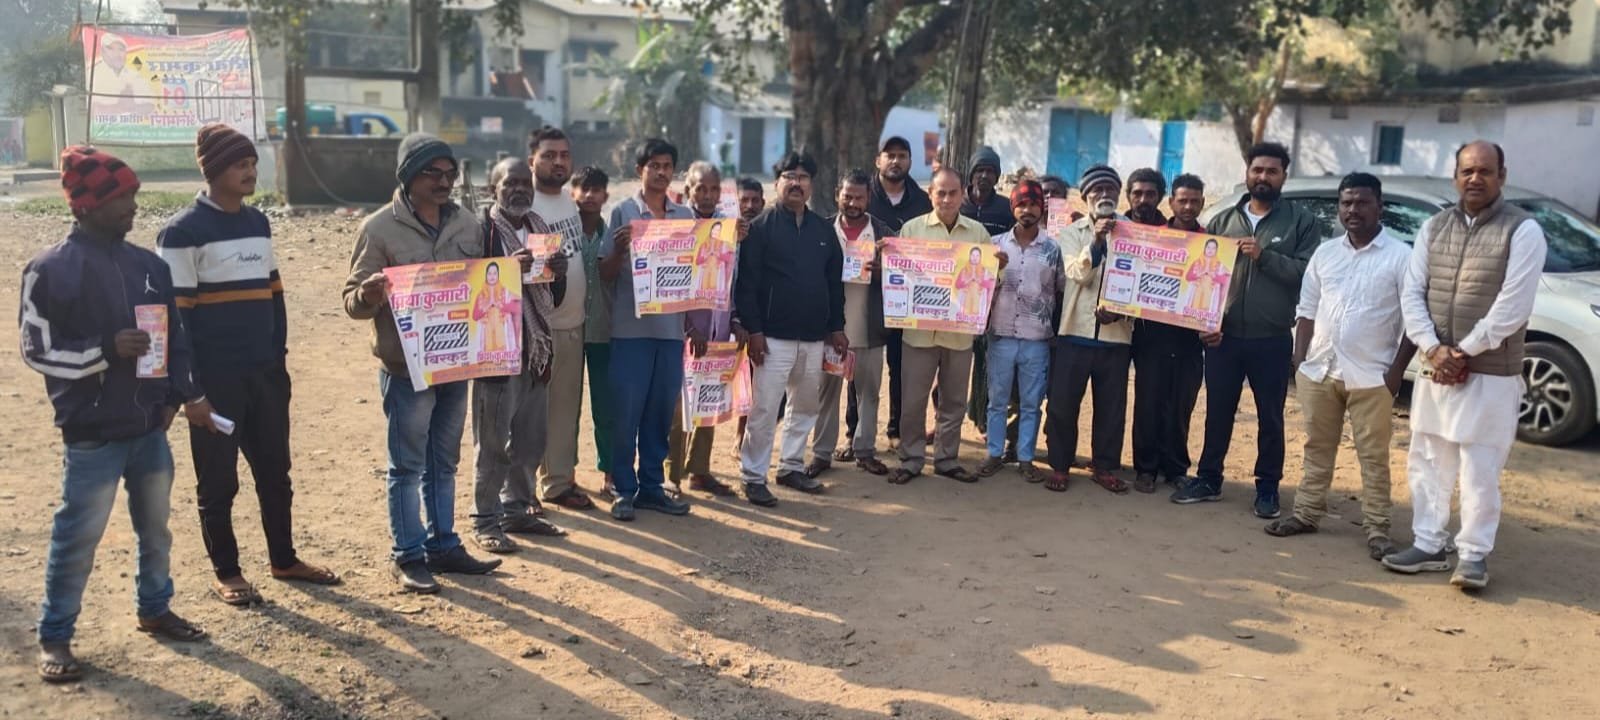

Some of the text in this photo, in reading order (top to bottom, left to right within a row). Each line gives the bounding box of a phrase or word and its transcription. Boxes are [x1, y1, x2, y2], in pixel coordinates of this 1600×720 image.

[657, 236, 695, 252] कुमारी
[1114, 239, 1187, 263] प्रिया कुमारी
[634, 257, 648, 270] 6
[886, 255, 955, 273] प्रिया कुमारी
[1115, 258, 1132, 271] 6
[889, 274, 904, 285] 6
[390, 284, 470, 310] प्रिया कुमारी
[424, 351, 469, 366] बिस्कुट
[704, 358, 735, 373] कुमारी
